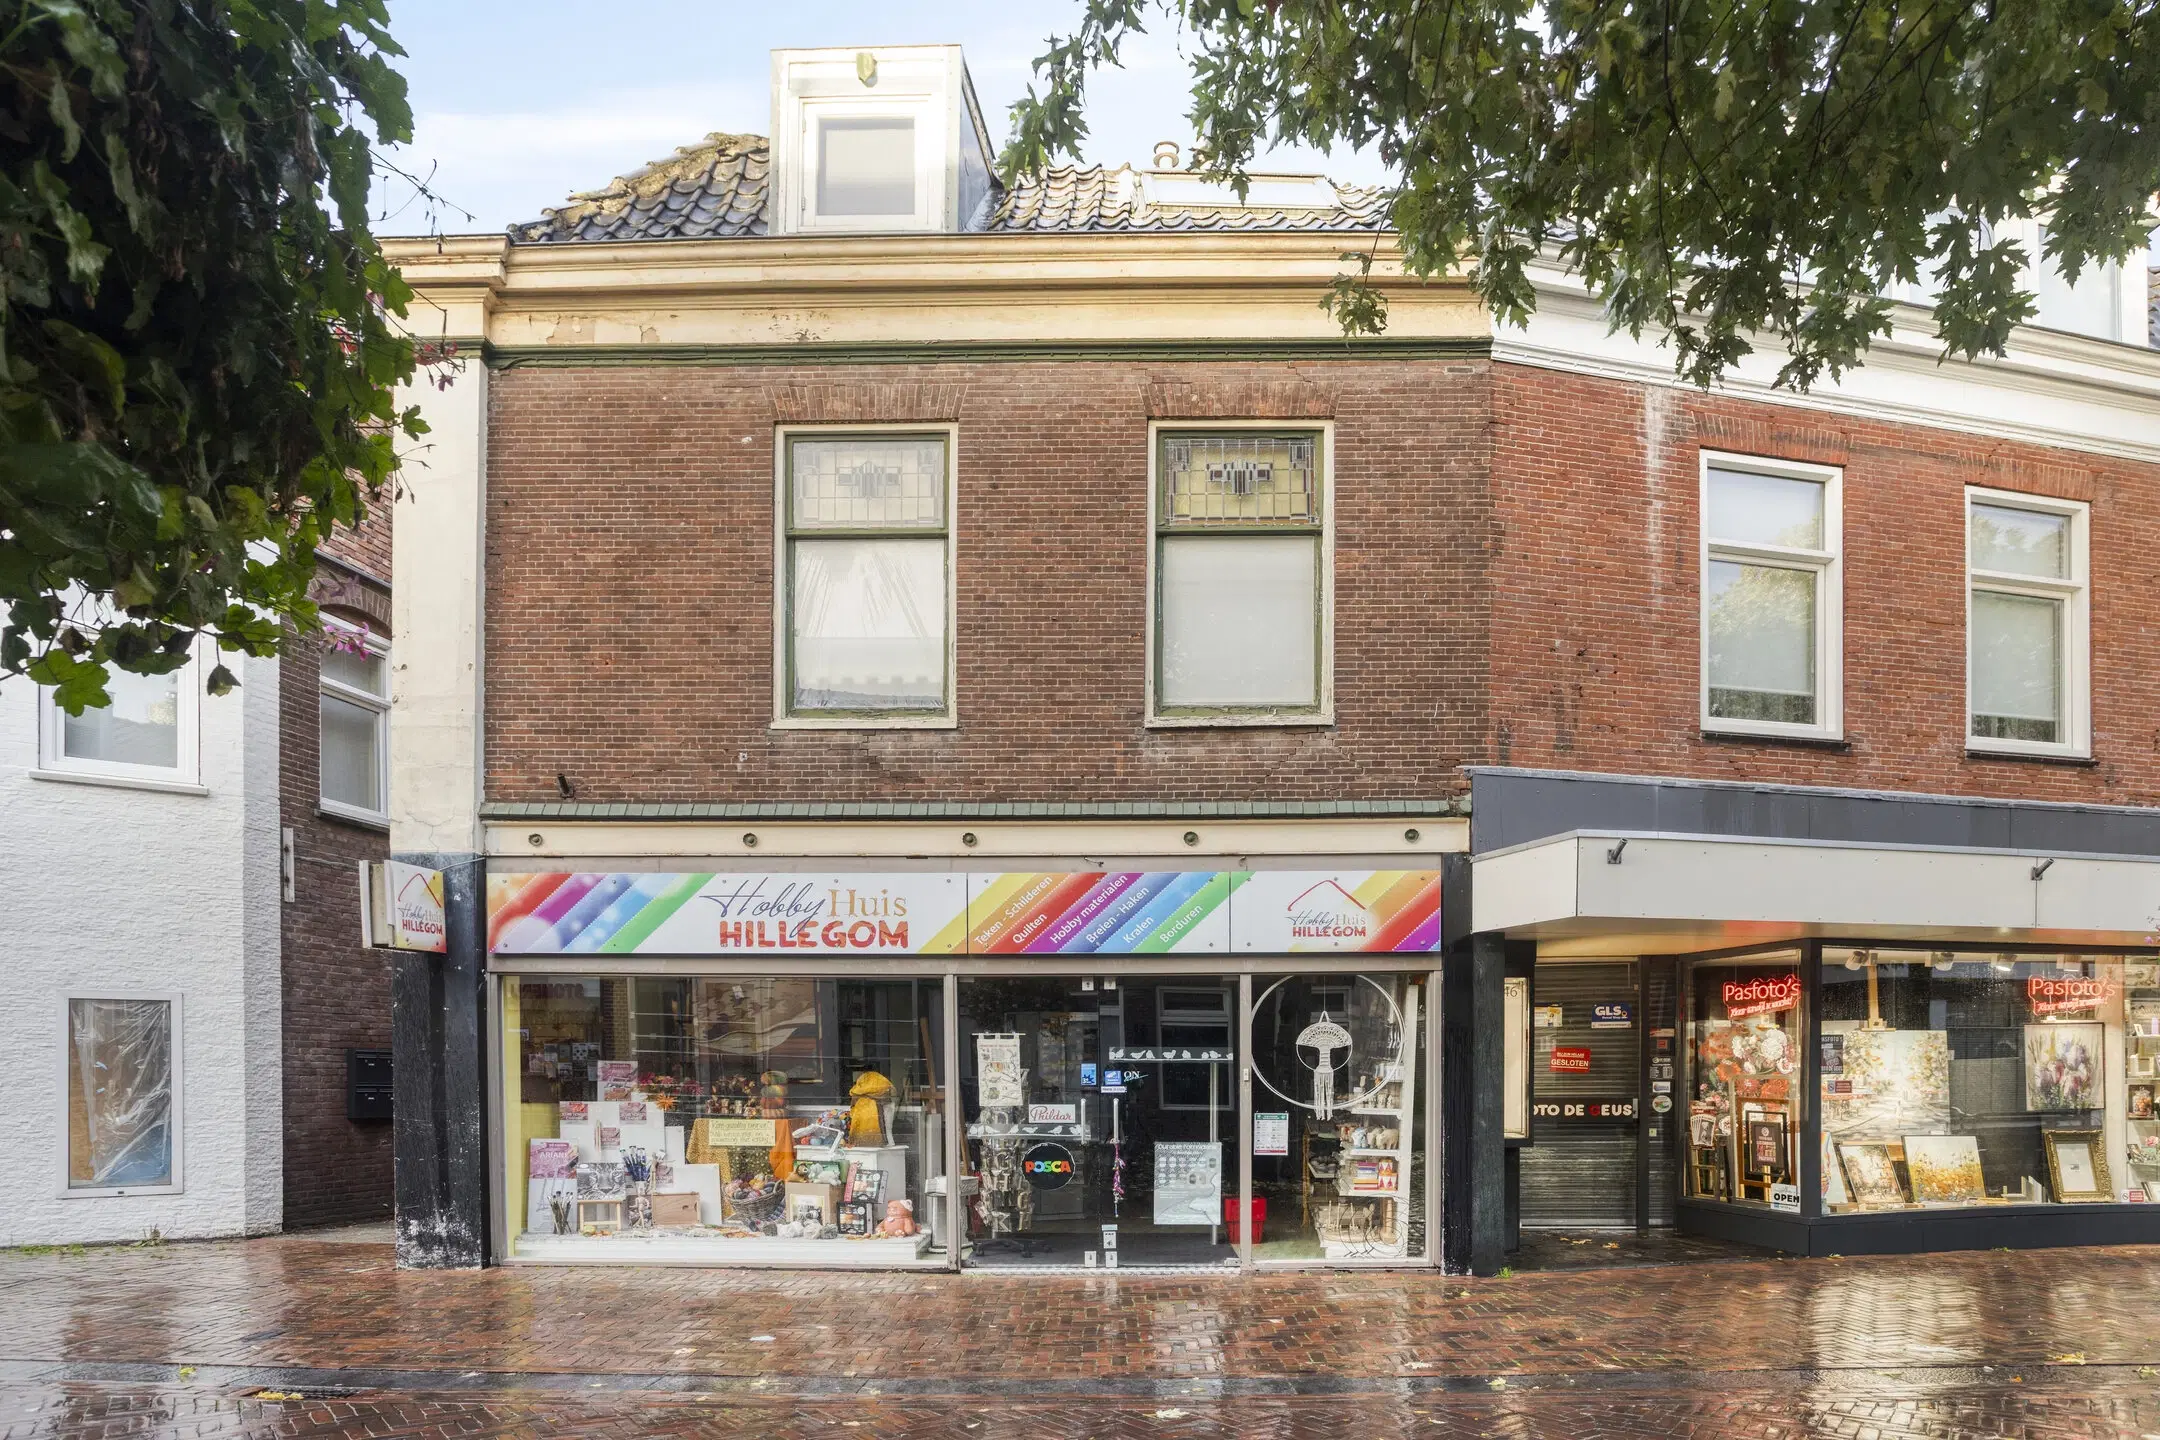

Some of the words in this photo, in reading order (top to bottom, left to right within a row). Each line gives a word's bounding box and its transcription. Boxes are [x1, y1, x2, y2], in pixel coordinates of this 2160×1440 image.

[699, 876, 826, 939] Hobby
[826, 887, 908, 918] Huis
[974, 920, 1004, 946] Teken
[1005, 876, 1053, 918] Schilderen
[1050, 915, 1082, 944] Hobby
[1081, 875, 1128, 918] materialen
[1118, 886, 1150, 914] Haken
[402, 919, 443, 935] HILLEGOM
[1012, 913, 1048, 944] Quilten
[1123, 916, 1155, 944] Kralen
[1159, 904, 1203, 944] Borduren
[1284, 909, 1335, 933] Hobby
[1335, 914, 1366, 925] Huis
[1292, 926, 1366, 937] HILLEGOM
[719, 920, 909, 949] HILLEGOM
[1725, 978, 1801, 1002] Pasfoto's
[2032, 978, 2116, 996] Pasfoto's
[1595, 1005, 1622, 1016] GLS
[1551, 1058, 1589, 1067] GESLOTEN
[1030, 1105, 1073, 1121] Phildar
[1564, 1104, 1585, 1116] DE
[1588, 1104, 1633, 1116] GEUS
[1025, 1160, 1072, 1173] POSCA
[1773, 1193, 1800, 1203] OPEN
